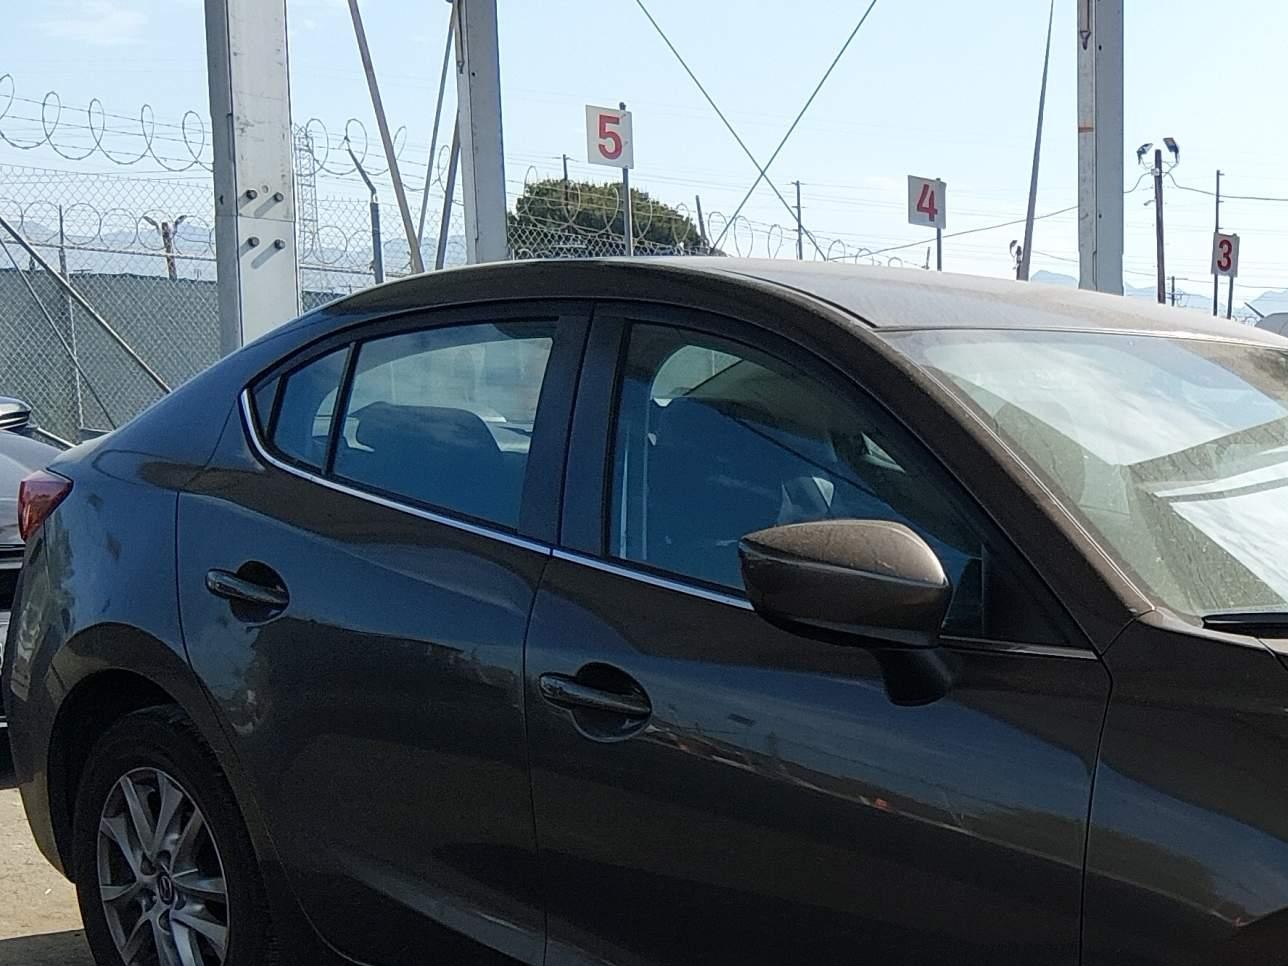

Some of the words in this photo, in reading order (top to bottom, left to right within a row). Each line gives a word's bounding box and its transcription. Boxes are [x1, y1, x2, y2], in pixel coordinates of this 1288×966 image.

[599, 114, 622, 160] 5
[917, 184, 938, 222] 4
[1217, 239, 1232, 272] 3
